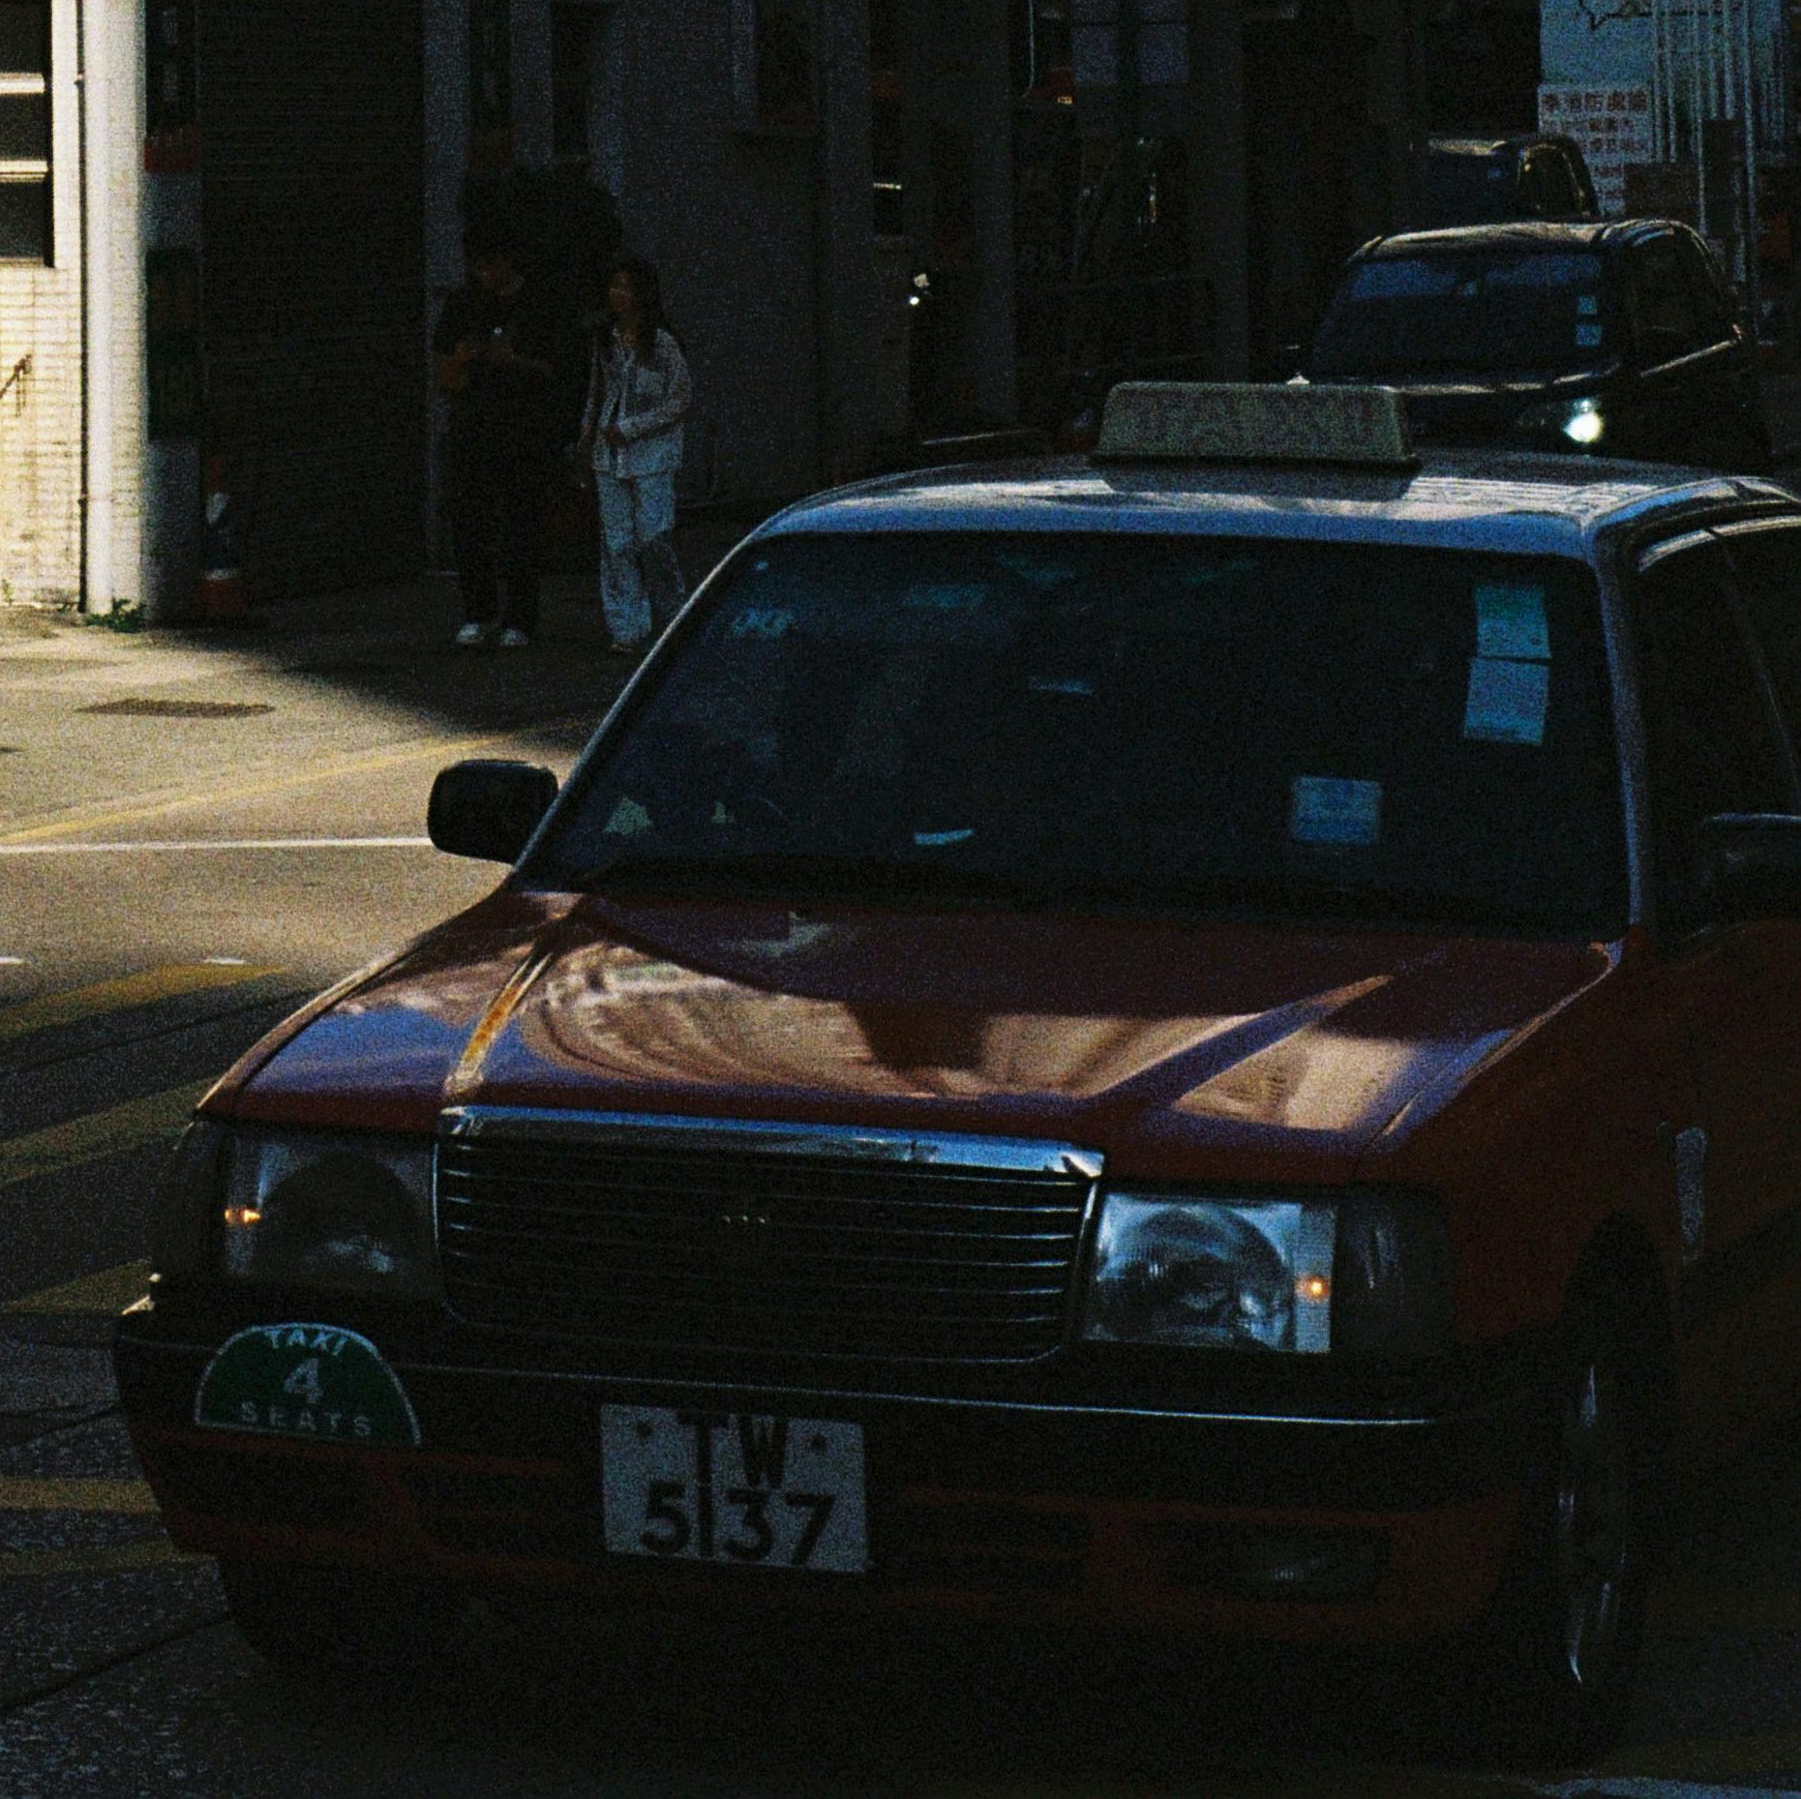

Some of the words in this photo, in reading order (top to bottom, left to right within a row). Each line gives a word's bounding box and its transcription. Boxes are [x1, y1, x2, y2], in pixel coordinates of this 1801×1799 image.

[1119, 389, 1378, 448] TAXI
[262, 1330, 348, 1358] TAXI
[282, 1356, 324, 1406] 4
[239, 1400, 373, 1439] SEATS
[679, 1409, 789, 1490] TW
[641, 1480, 837, 1566] 5137
